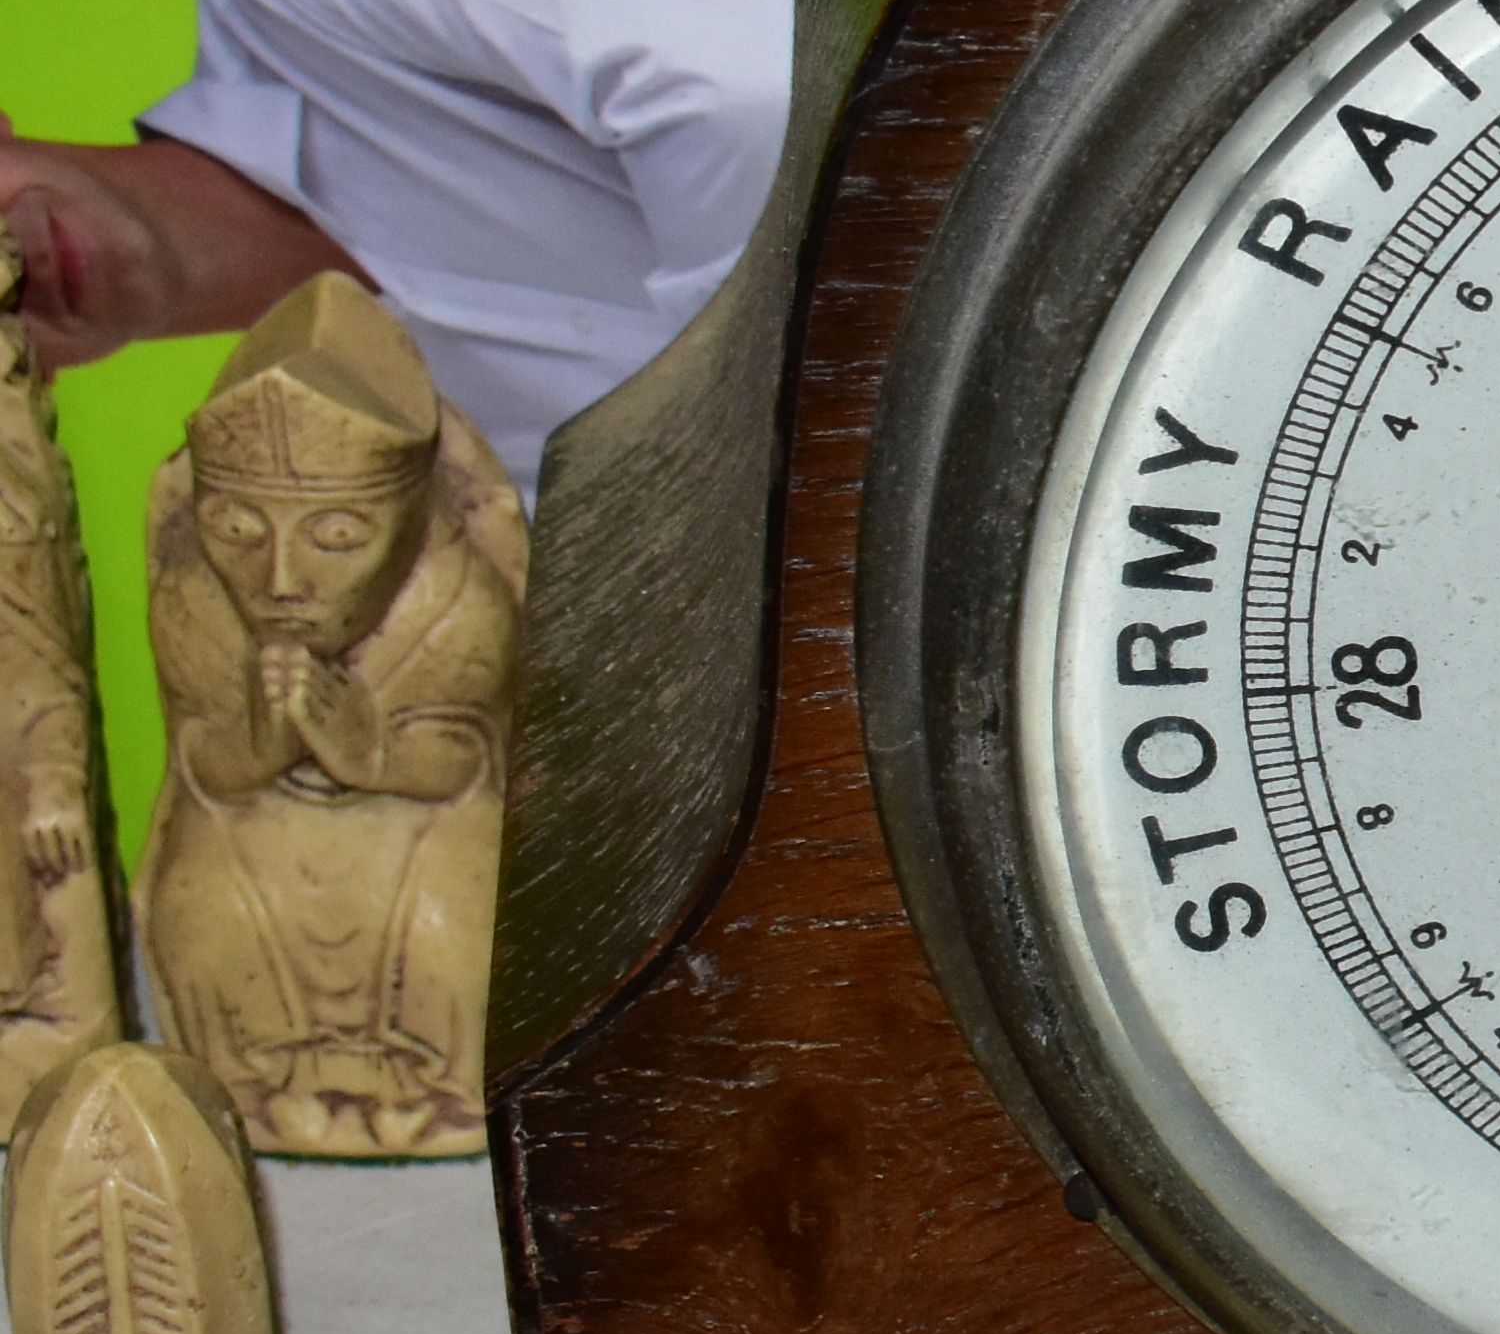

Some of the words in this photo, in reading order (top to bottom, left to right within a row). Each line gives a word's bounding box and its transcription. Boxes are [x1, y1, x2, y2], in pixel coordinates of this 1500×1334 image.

[1456, 282, 1492, 311] 6
[1383, 414, 1418, 441] 4
[1341, 540, 1384, 566] 2
[1117, 407, 1266, 952] STORMY
[1331, 636, 1421, 729] 28
[1356, 804, 1394, 830] 8
[1410, 922, 1447, 949] 6
